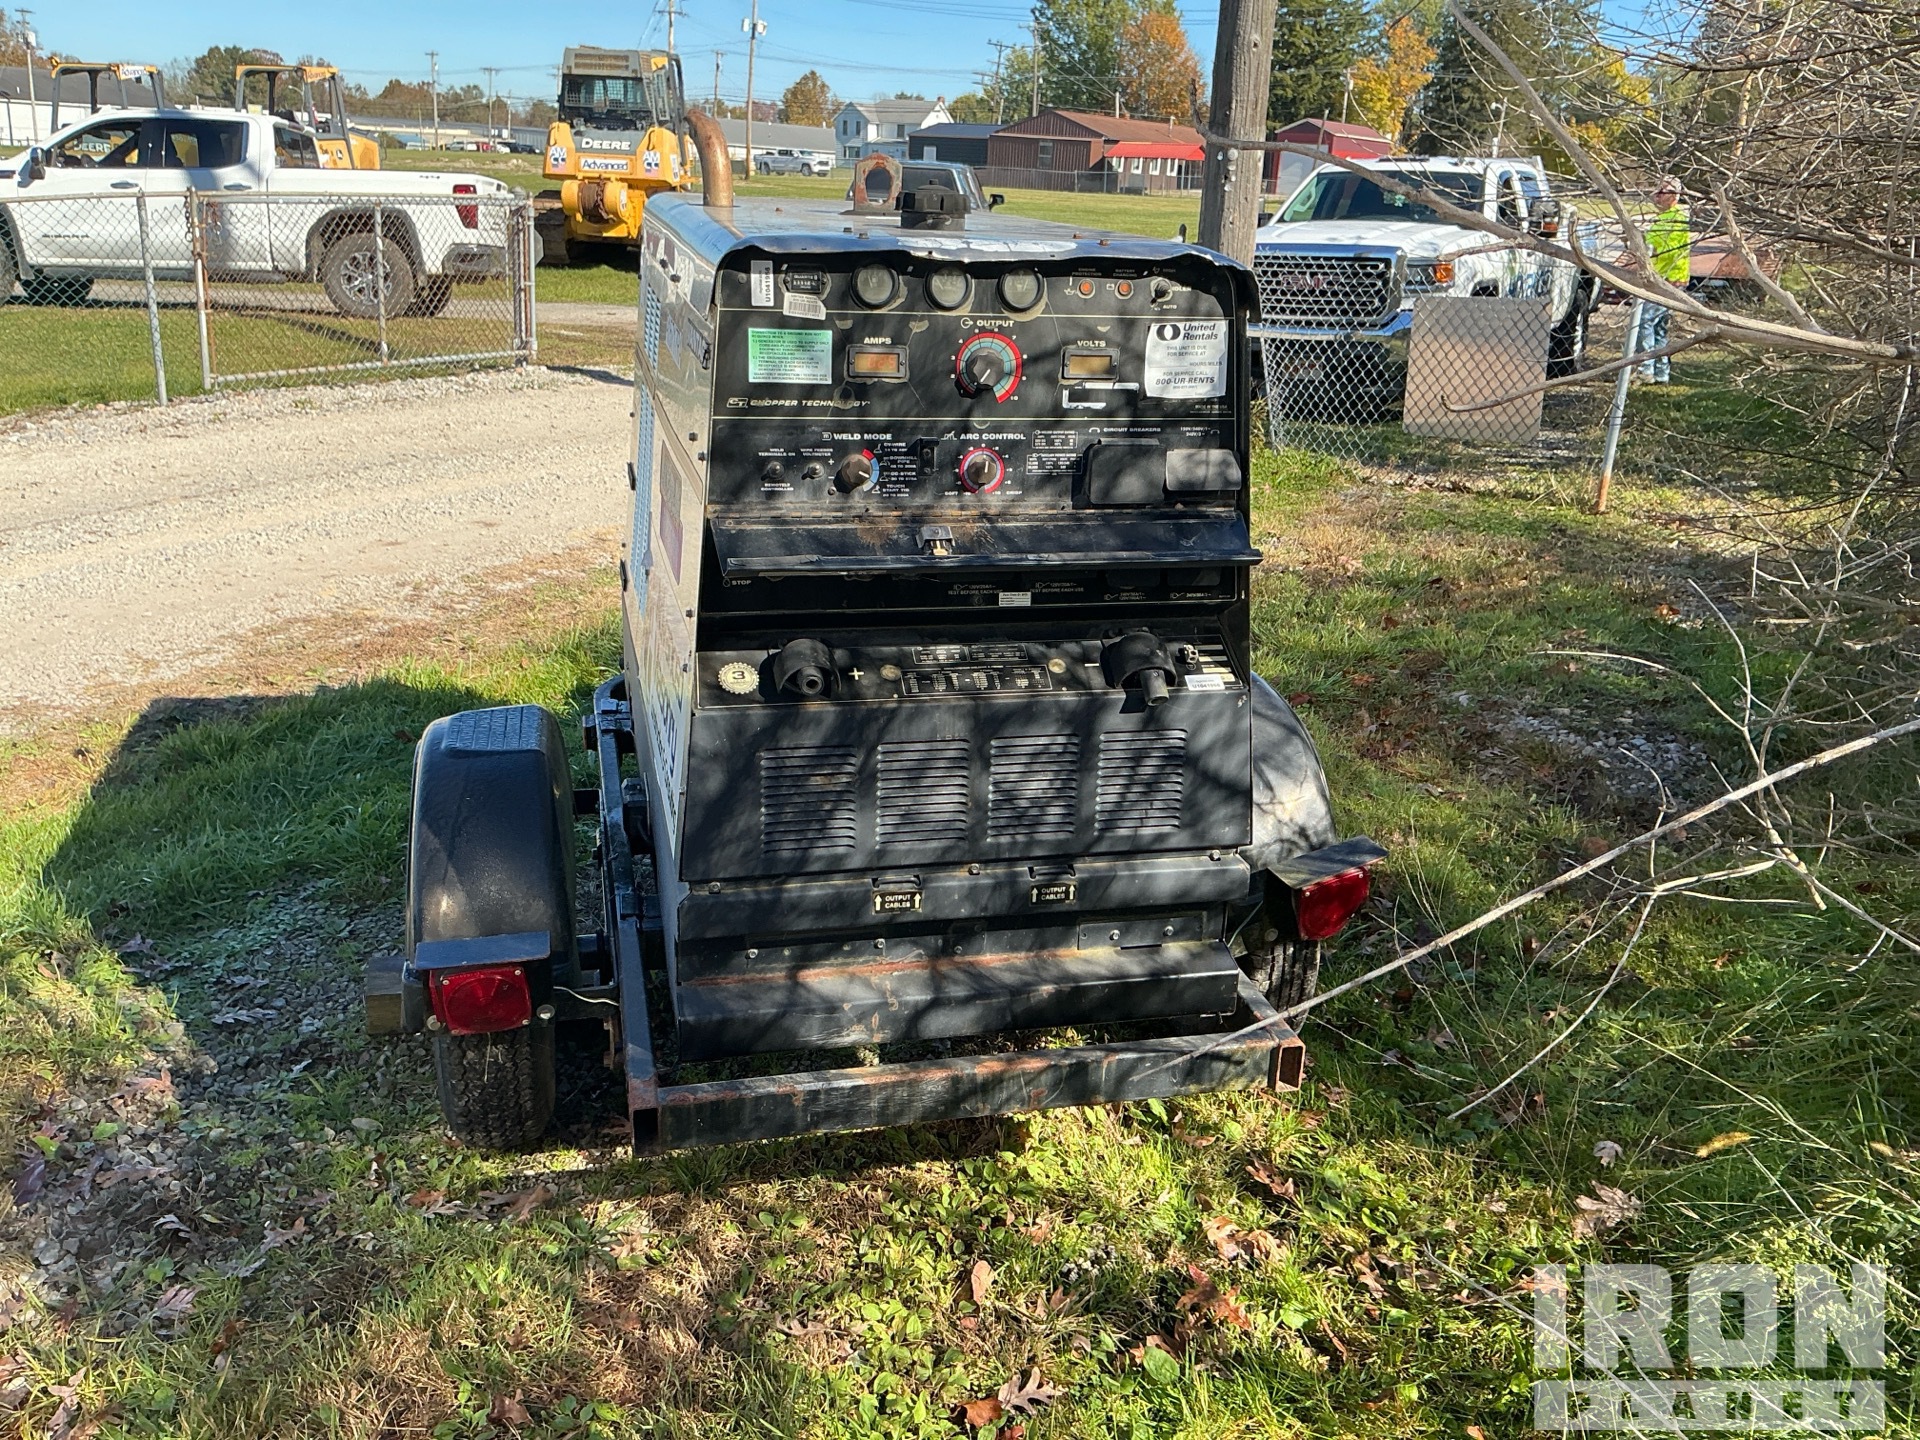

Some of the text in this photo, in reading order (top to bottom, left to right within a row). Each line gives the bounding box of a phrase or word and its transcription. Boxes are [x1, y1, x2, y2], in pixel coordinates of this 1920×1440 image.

[582, 138, 631, 150] DEERE
[582, 160, 628, 170] Advanced
[1184, 323, 1216, 331] United
[1156, 377, 1215, 385] 800-UR-RENTS
[732, 670, 746, 680] 3
